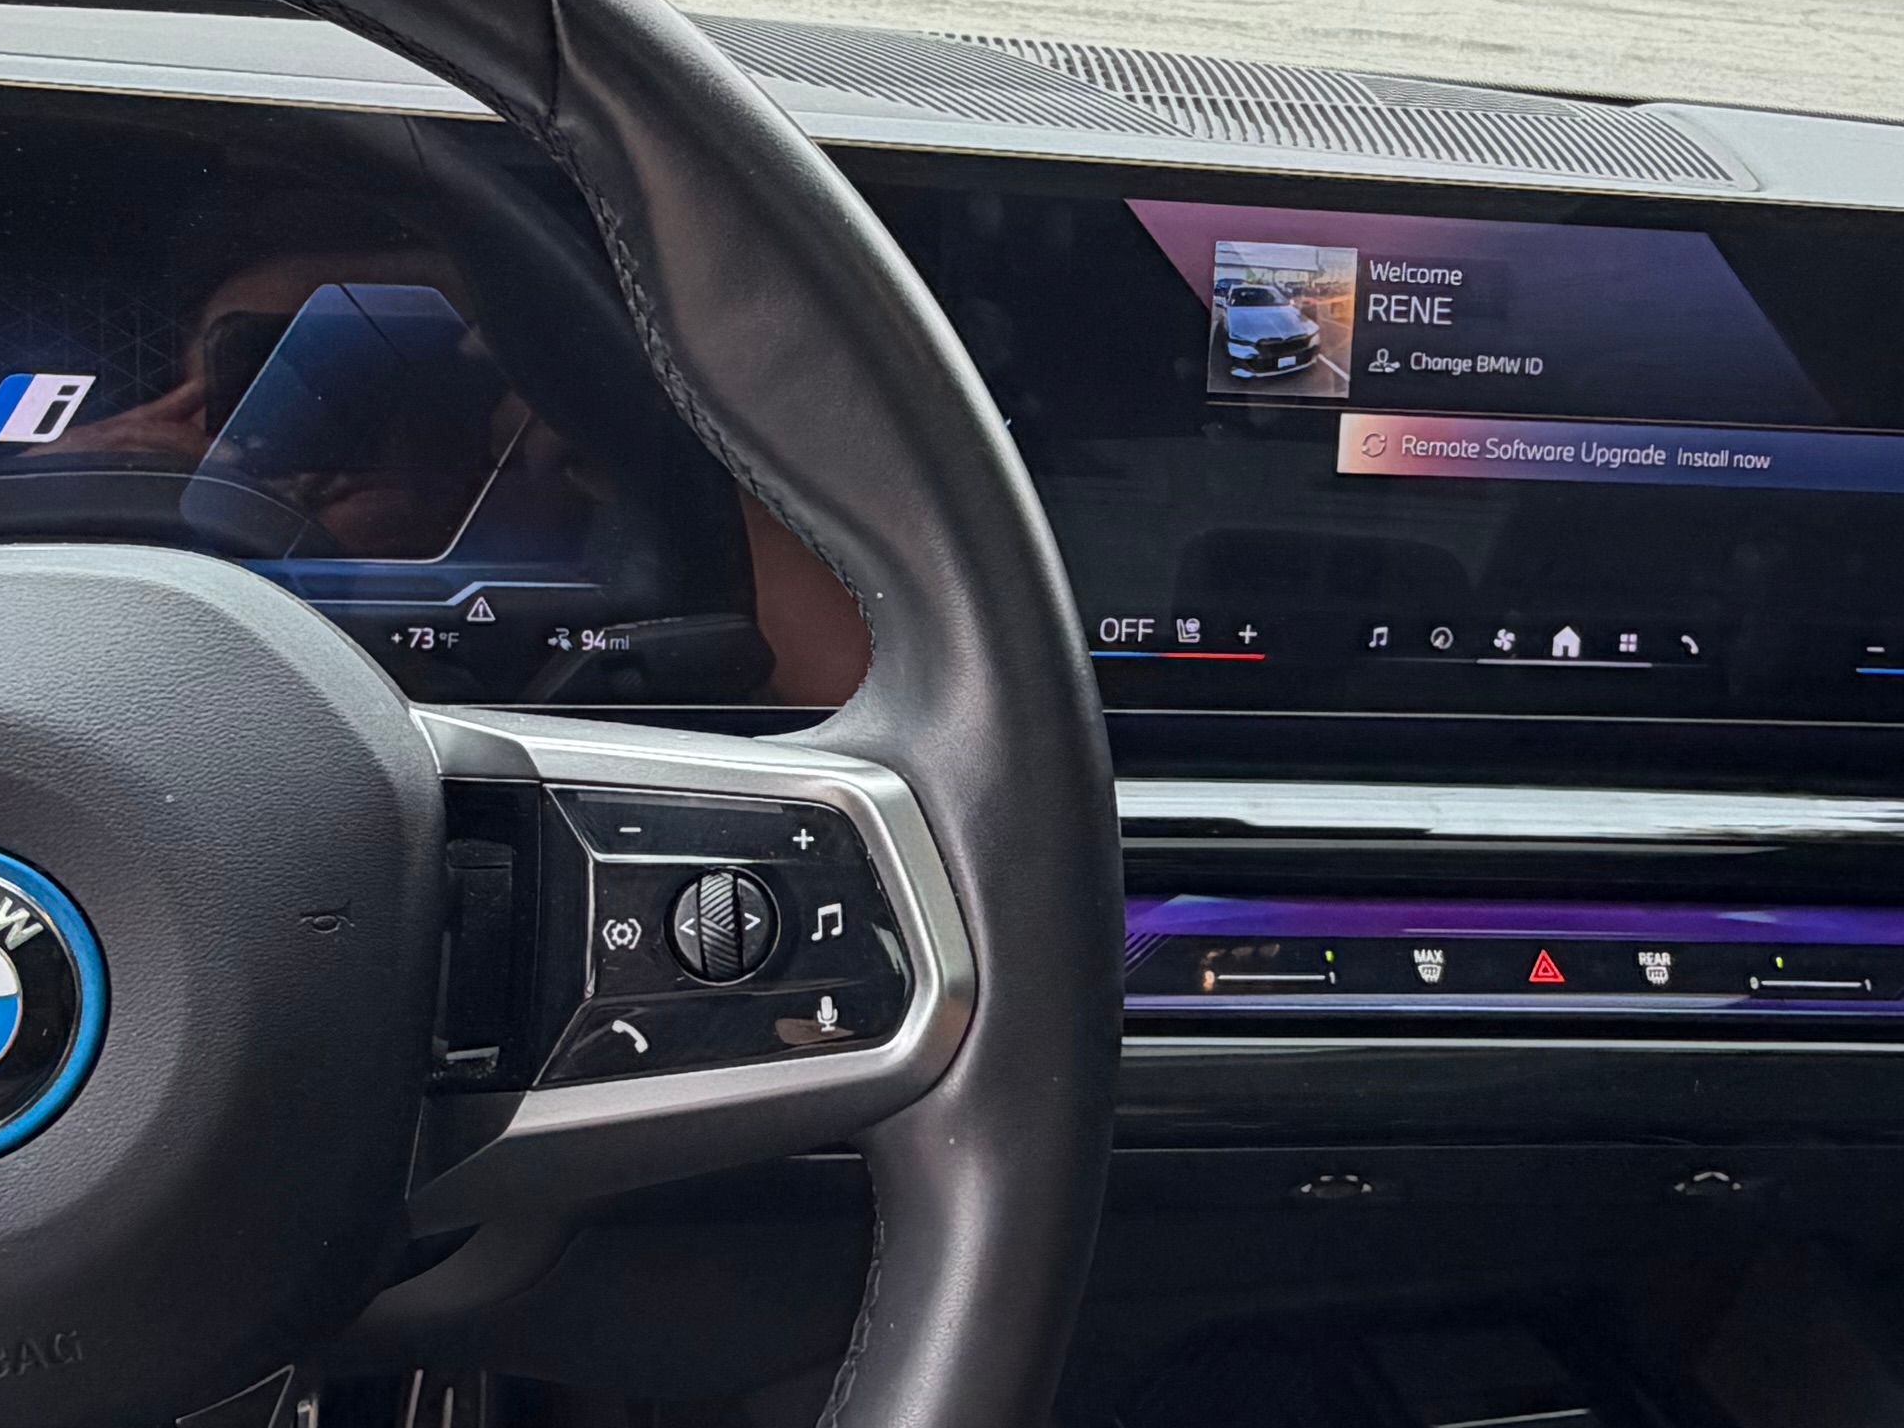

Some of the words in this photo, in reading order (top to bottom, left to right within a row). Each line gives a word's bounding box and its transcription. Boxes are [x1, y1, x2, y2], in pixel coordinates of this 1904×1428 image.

[1369, 261, 1463, 286] Welcome
[1368, 295, 1453, 325] RENE
[1410, 353, 1473, 375] Change
[1477, 355, 1521, 375] BMW
[1524, 357, 1543, 375] ID
[1401, 435, 1480, 459] Remote
[1485, 437, 1575, 463] Software
[1580, 440, 1667, 469] Upgrade
[1677, 447, 1729, 469] Install
[1733, 454, 1771, 470] now
[1099, 617, 1155, 643] OFF
[1413, 948, 1443, 964] MAX
[1638, 951, 1671, 966] REAR
